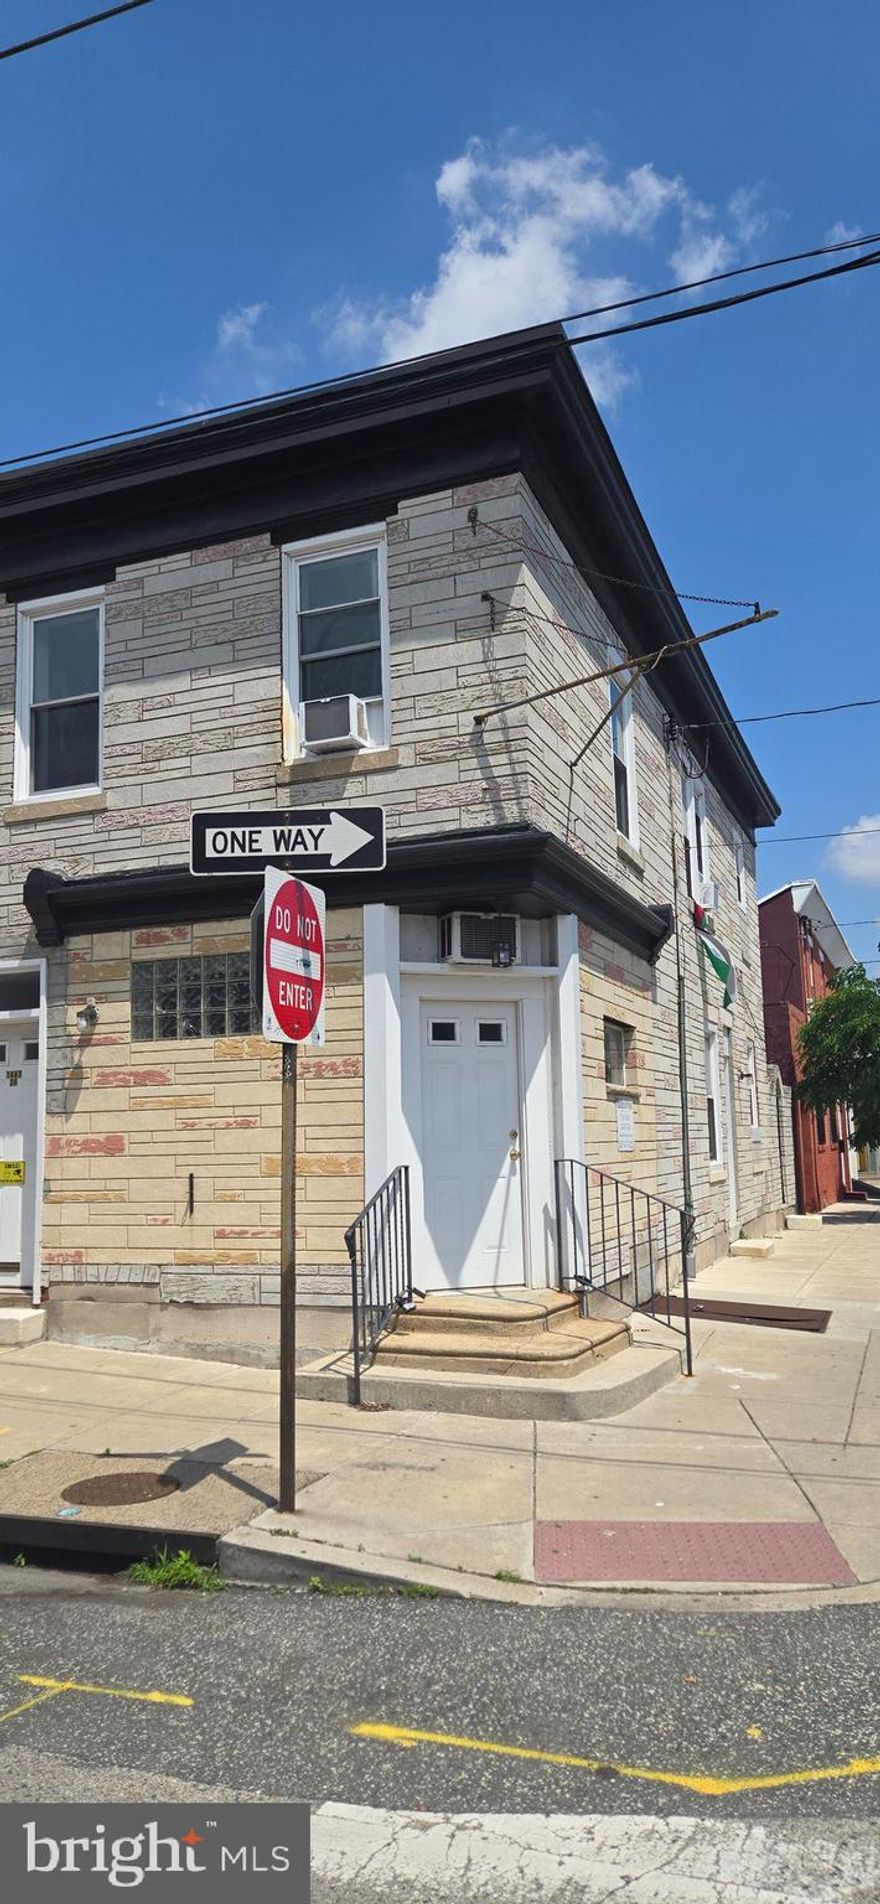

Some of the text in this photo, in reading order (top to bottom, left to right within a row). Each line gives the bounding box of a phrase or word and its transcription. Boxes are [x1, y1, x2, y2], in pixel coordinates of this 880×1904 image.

[212, 828, 326, 854] ONE WAY
[275, 905, 317, 942] DO NOT
[278, 981, 313, 1011] ENTER
